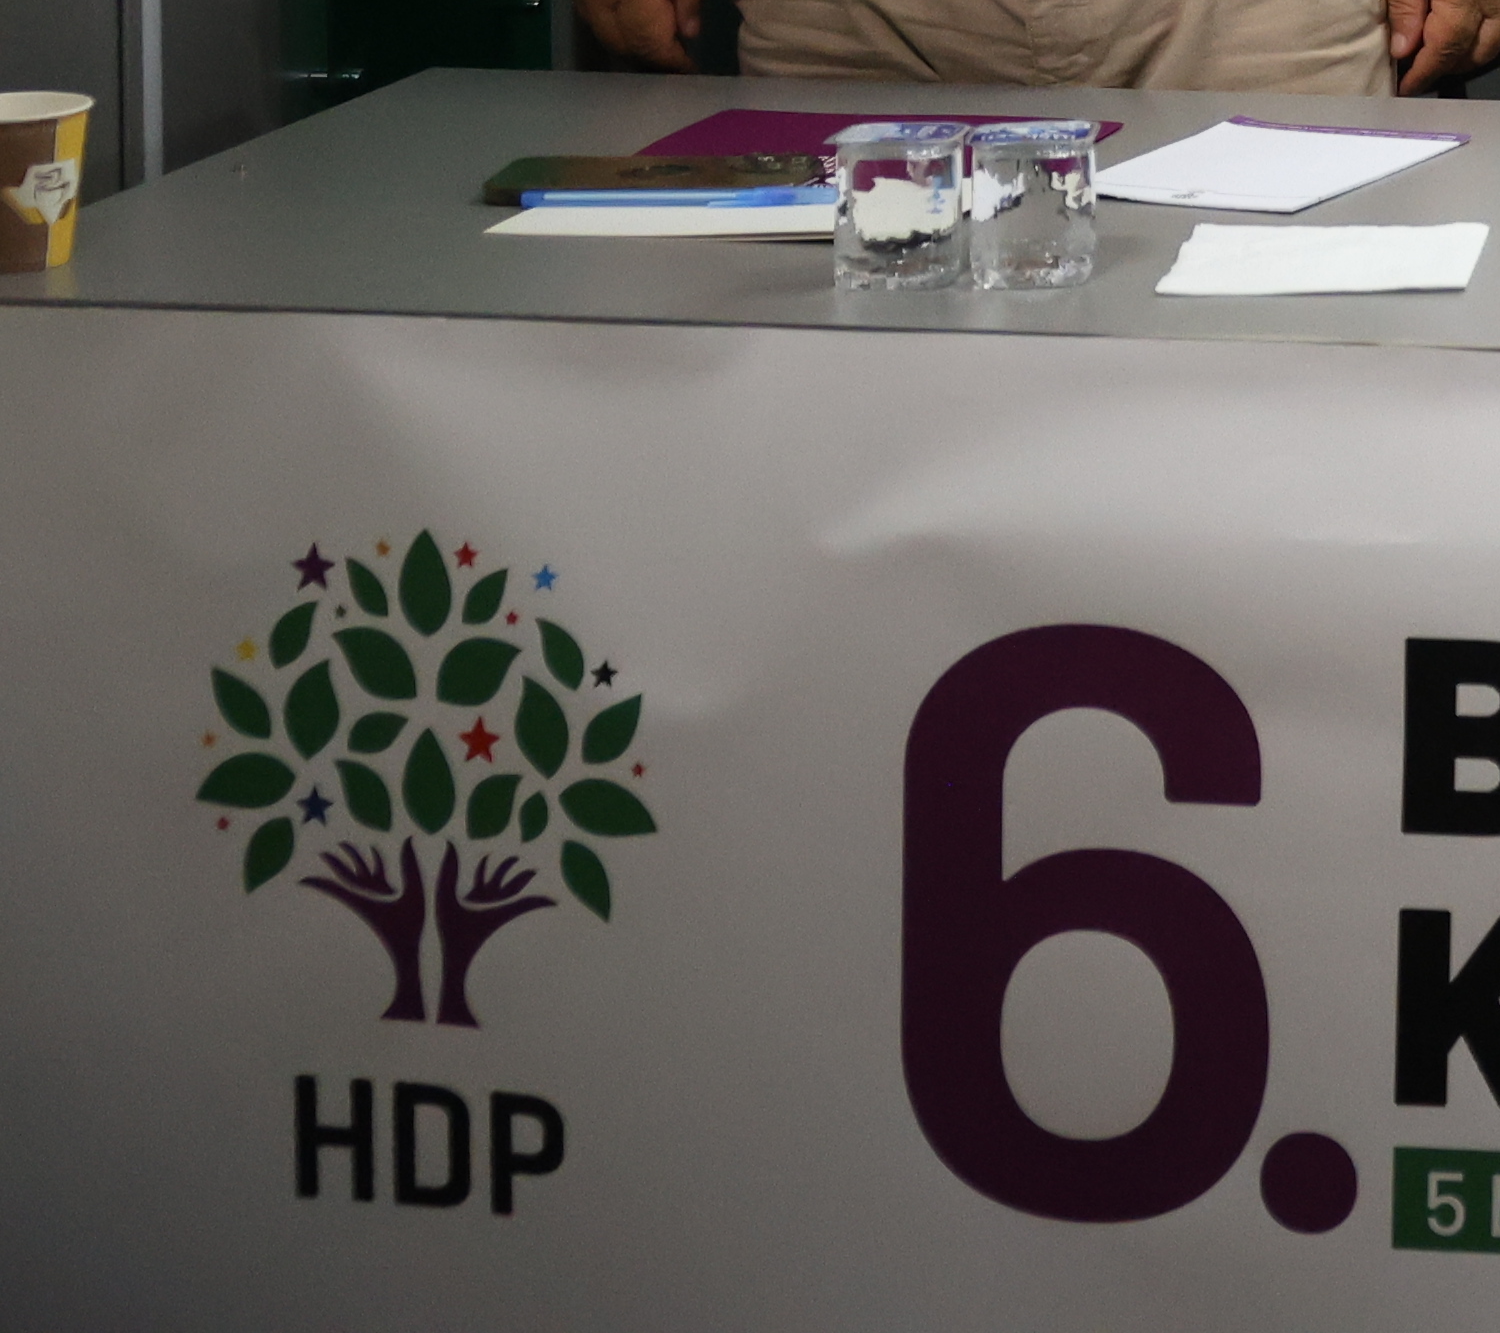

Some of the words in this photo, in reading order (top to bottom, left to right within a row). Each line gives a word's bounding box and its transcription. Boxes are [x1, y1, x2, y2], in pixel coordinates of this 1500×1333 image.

[899, 622, 1360, 1236] 6.
[293, 1073, 566, 1218] HDP
[1425, 1170, 1468, 1239] 5
